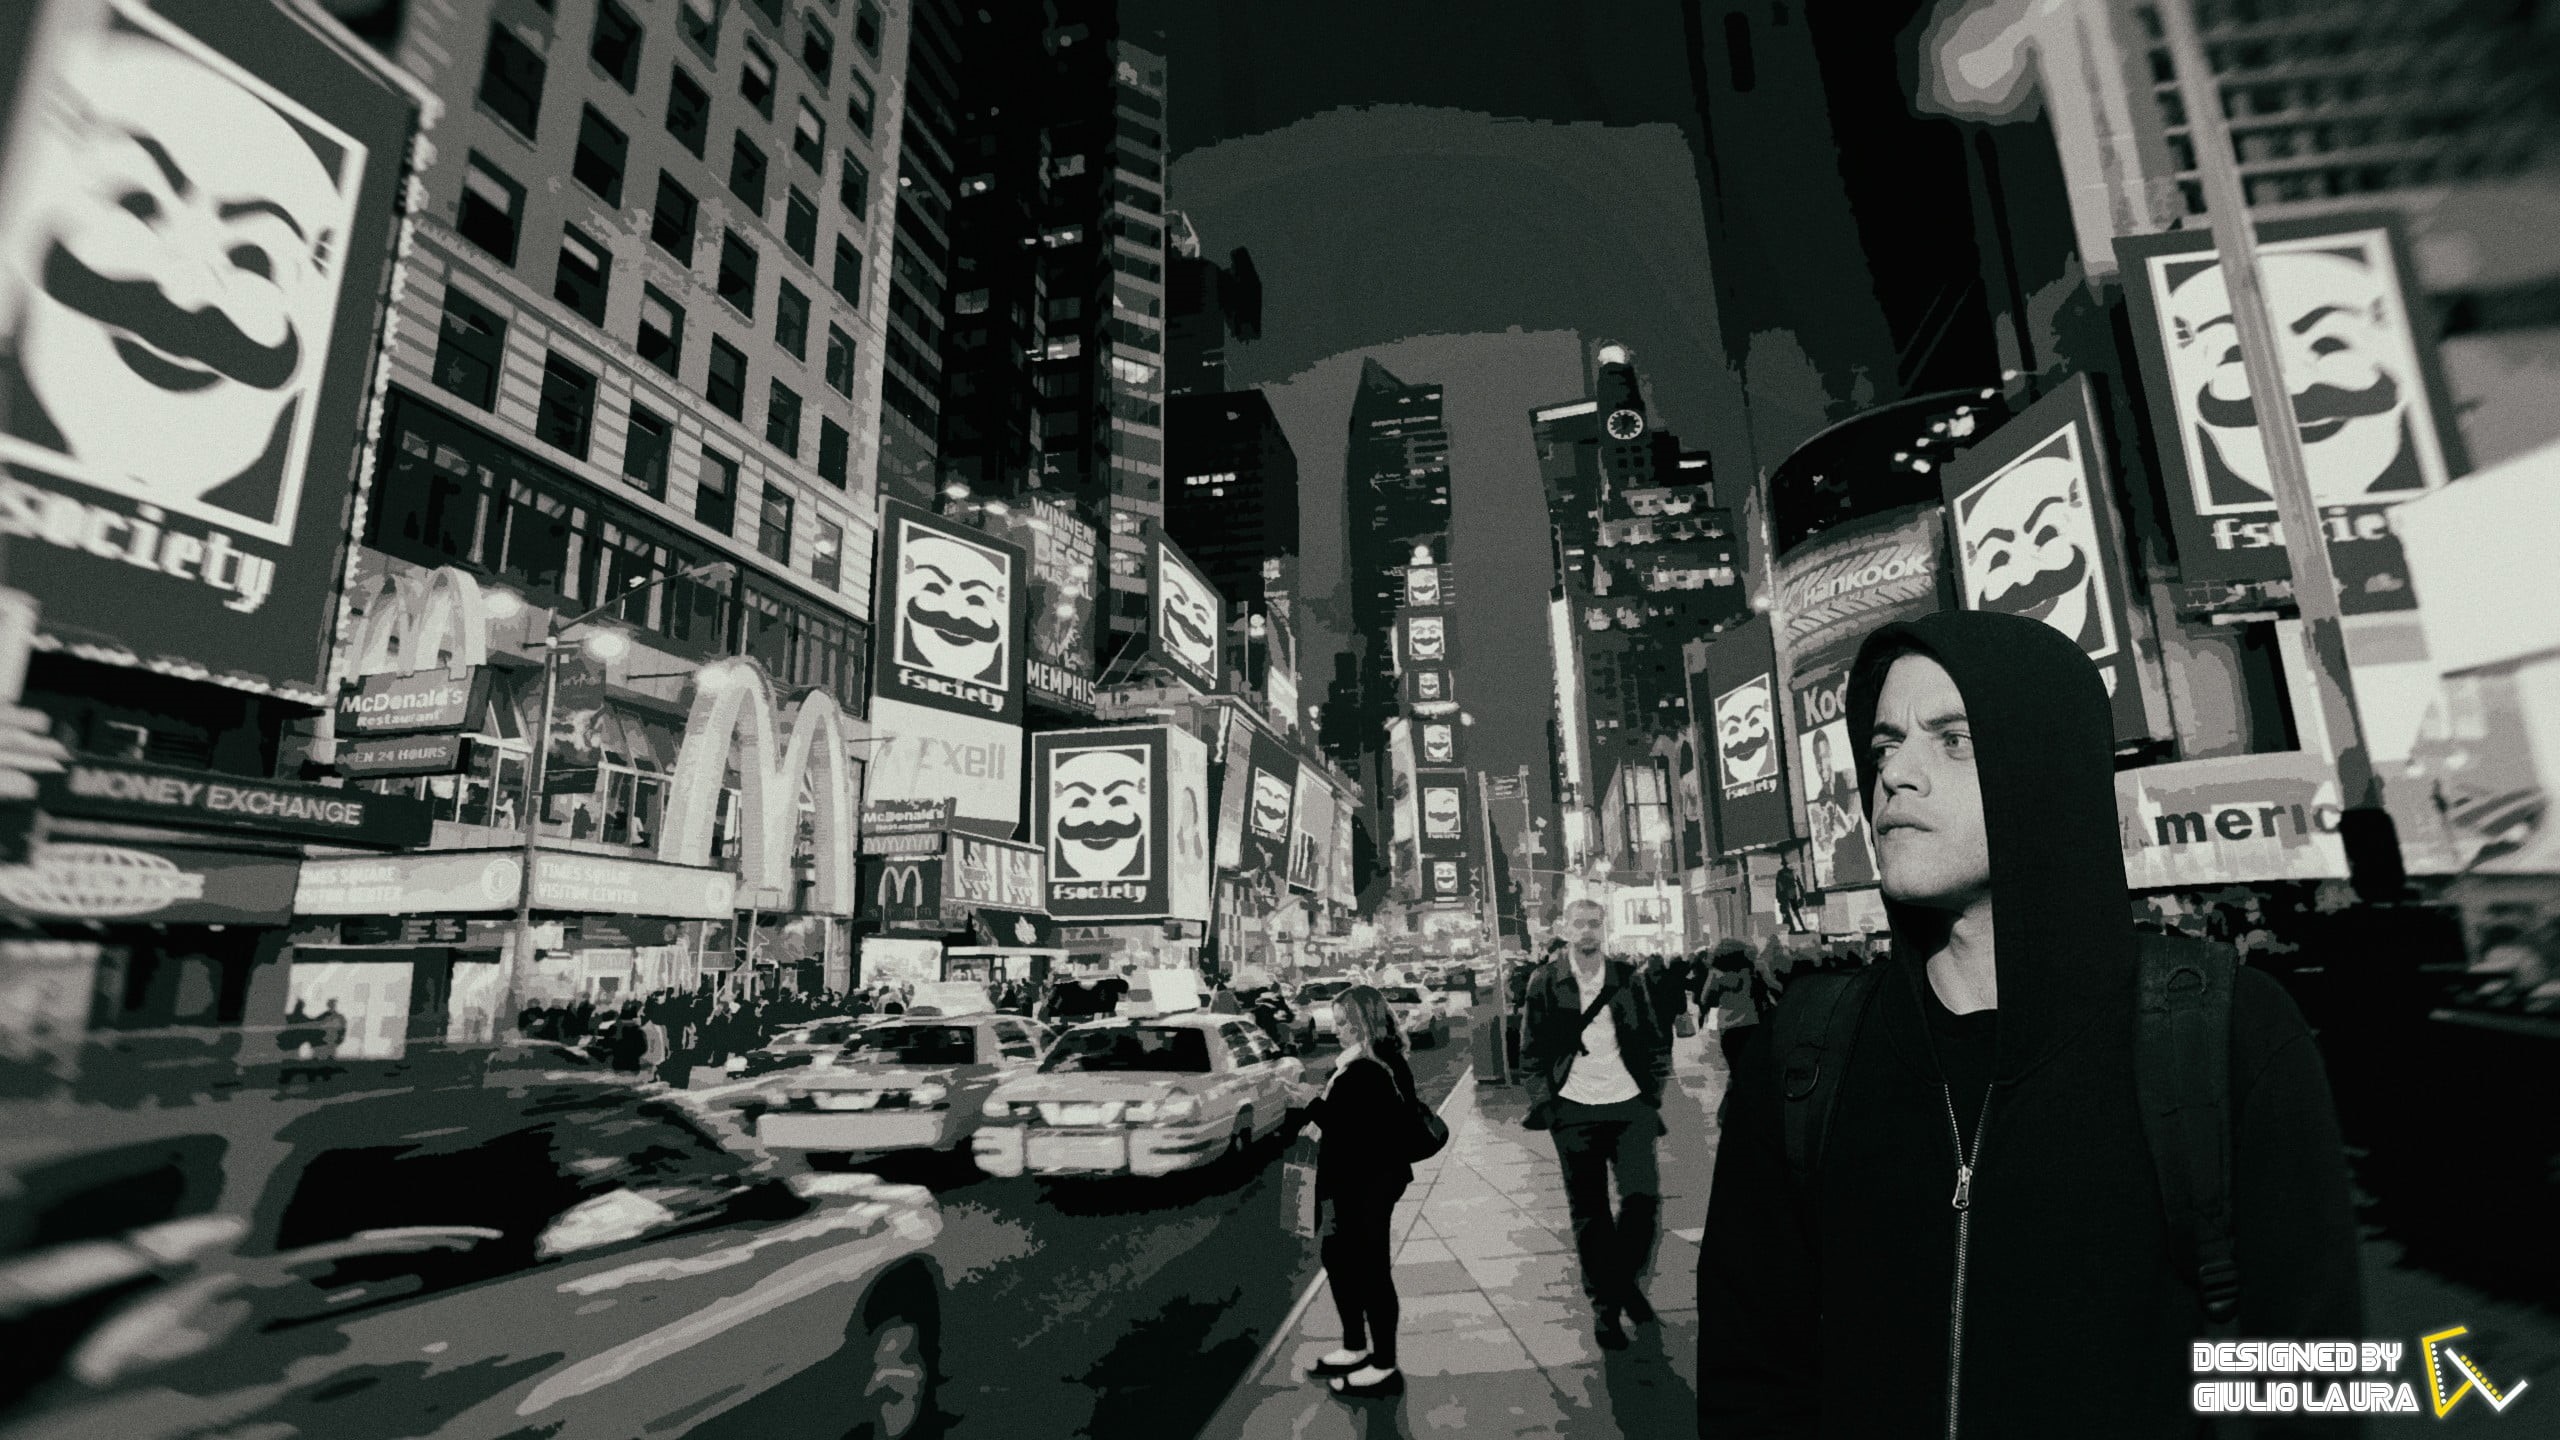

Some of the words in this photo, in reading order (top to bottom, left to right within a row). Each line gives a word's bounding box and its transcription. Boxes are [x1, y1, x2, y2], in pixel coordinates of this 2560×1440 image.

[0, 472, 276, 613] society
[340, 687, 464, 713] McDonald's
[1027, 659, 1096, 705] MEMPHIS
[1803, 670, 1850, 727] Kod
[398, 746, 447, 761] HOURS
[68, 766, 203, 807] MONEY
[206, 785, 363, 825] EXCHANGE
[1053, 882, 1147, 903] fsociety
